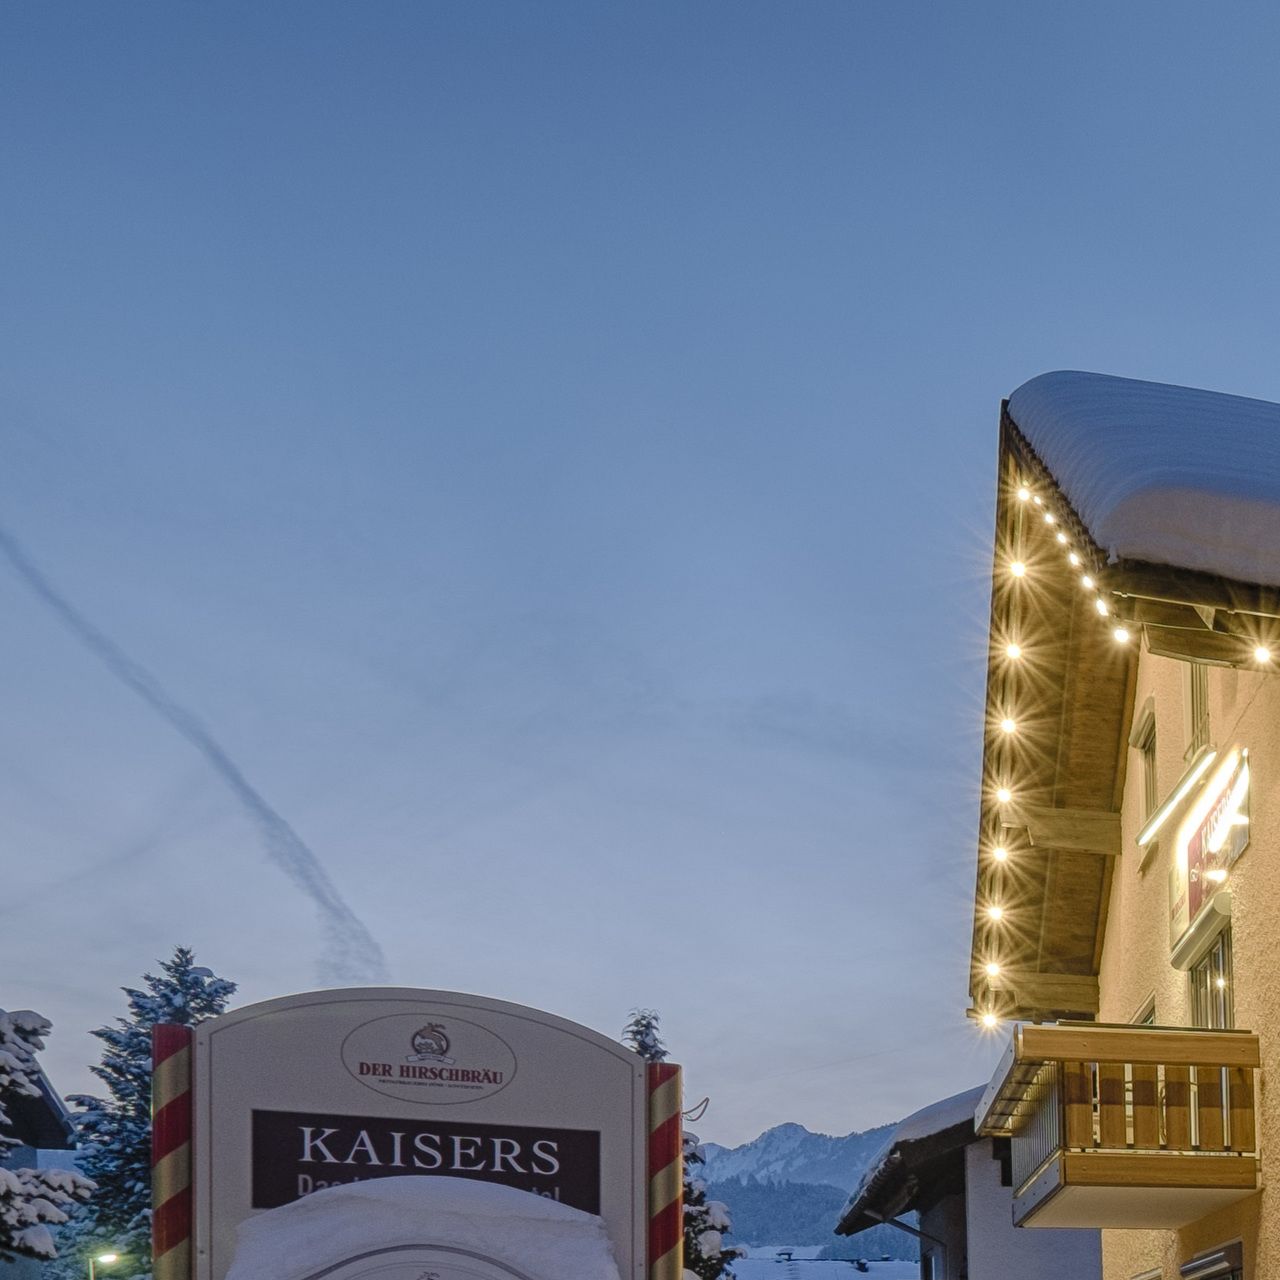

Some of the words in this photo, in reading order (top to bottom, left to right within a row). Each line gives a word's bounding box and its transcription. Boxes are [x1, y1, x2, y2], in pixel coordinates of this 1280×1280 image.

[359, 1062, 393, 1077] DER
[400, 1065, 503, 1085] HIRSCHBRÄU
[298, 1127, 560, 1175] KAISERS
